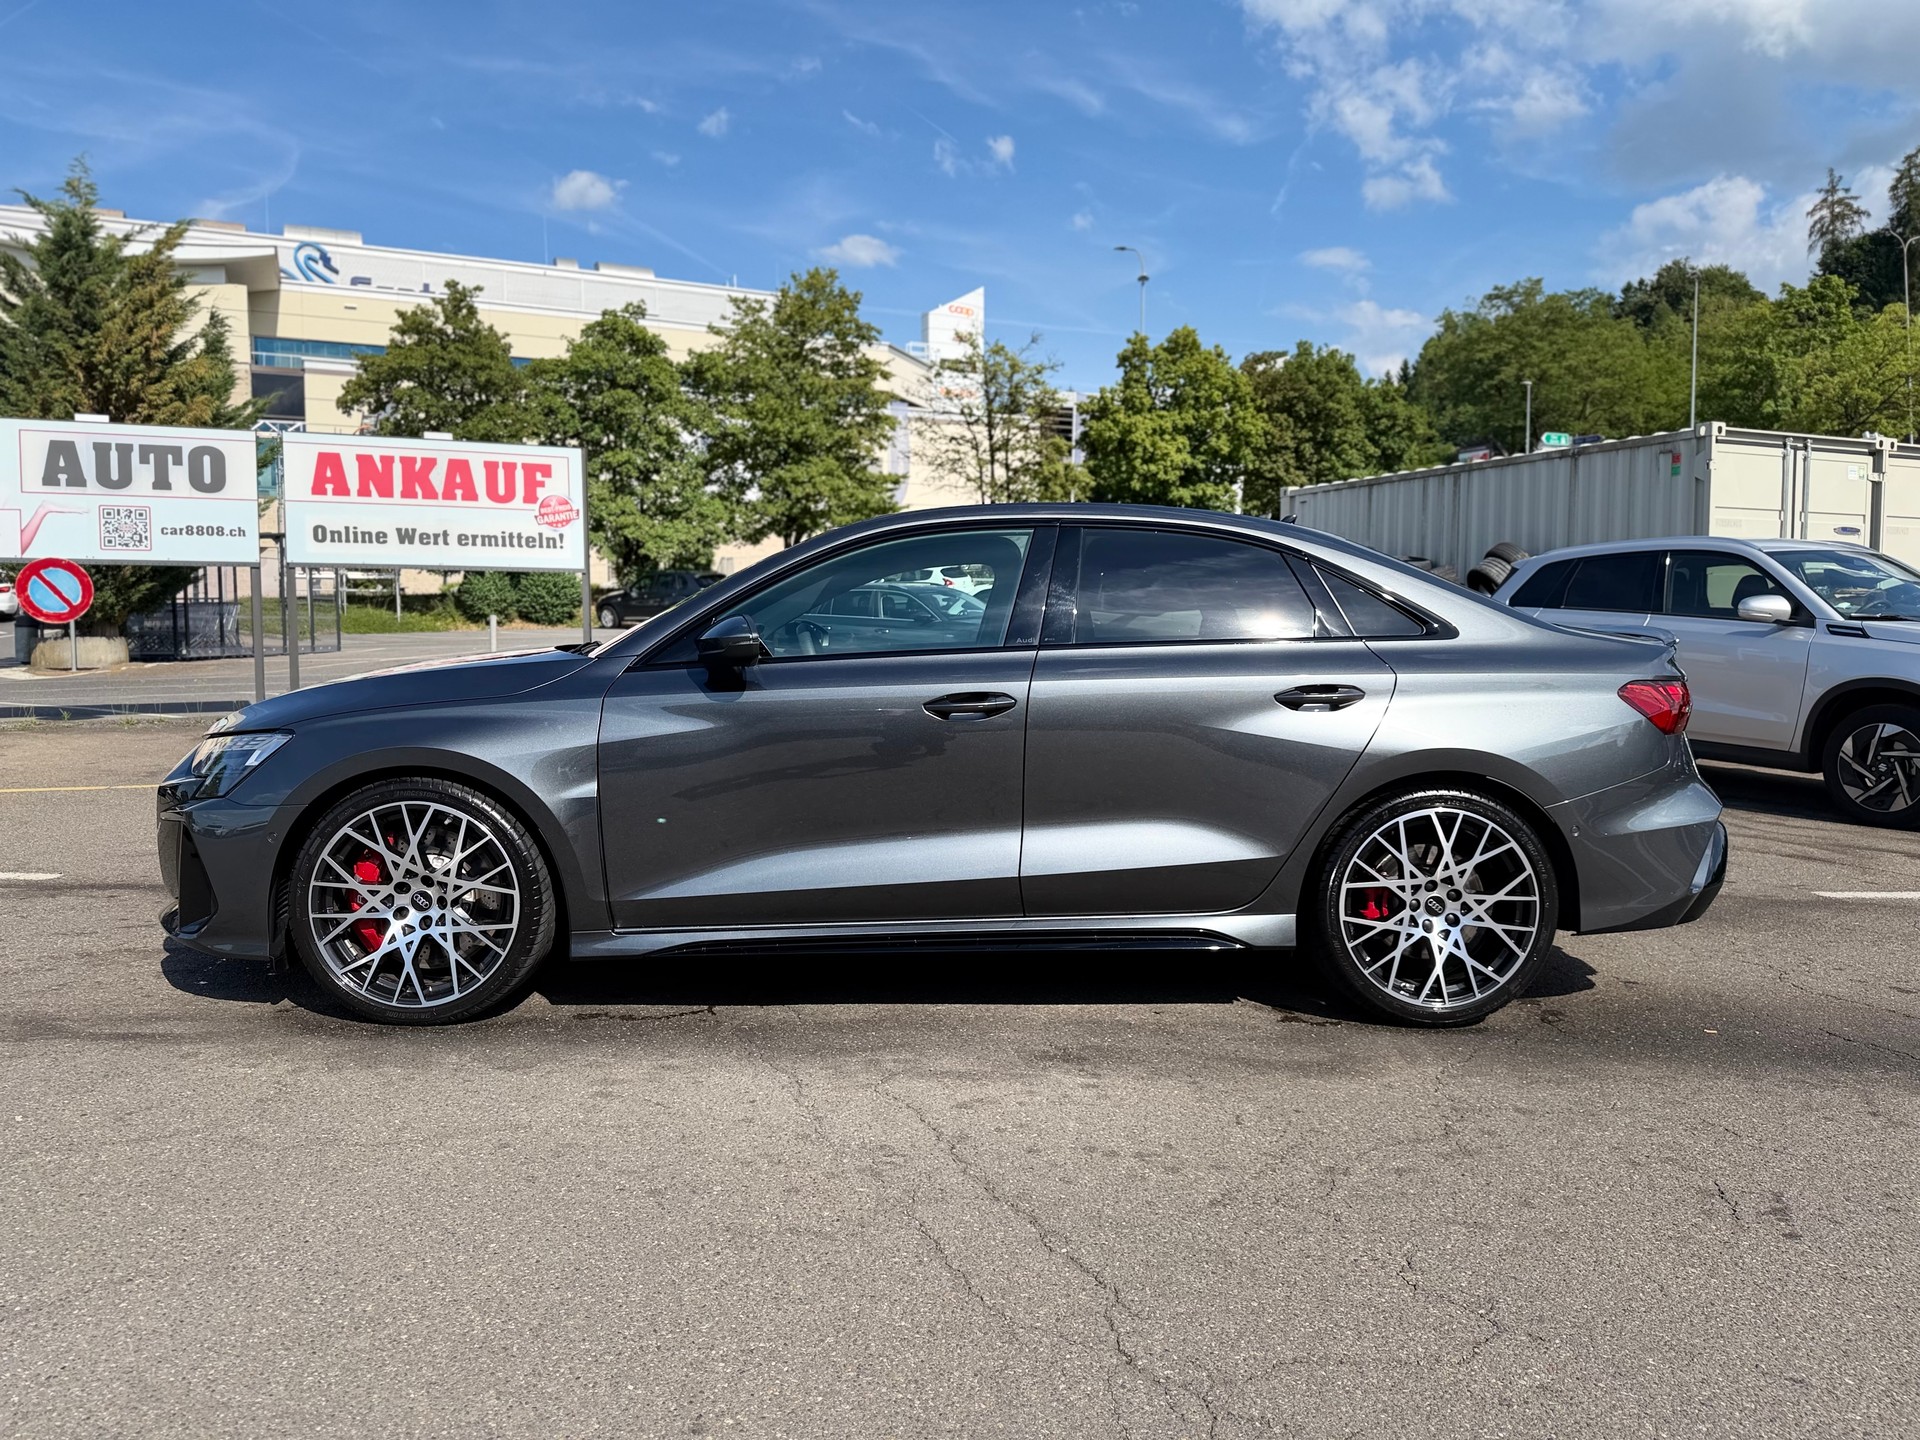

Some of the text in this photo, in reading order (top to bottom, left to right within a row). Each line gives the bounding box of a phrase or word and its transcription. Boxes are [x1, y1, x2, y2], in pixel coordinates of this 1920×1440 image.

[949, 304, 974, 318] coop
[42, 439, 227, 494] AUTO
[311, 451, 553, 504] ANKAUF
[536, 510, 579, 524] GARANTIE
[160, 525, 247, 538] car8808.ch
[312, 524, 565, 550] Online Wert ermitteln!
